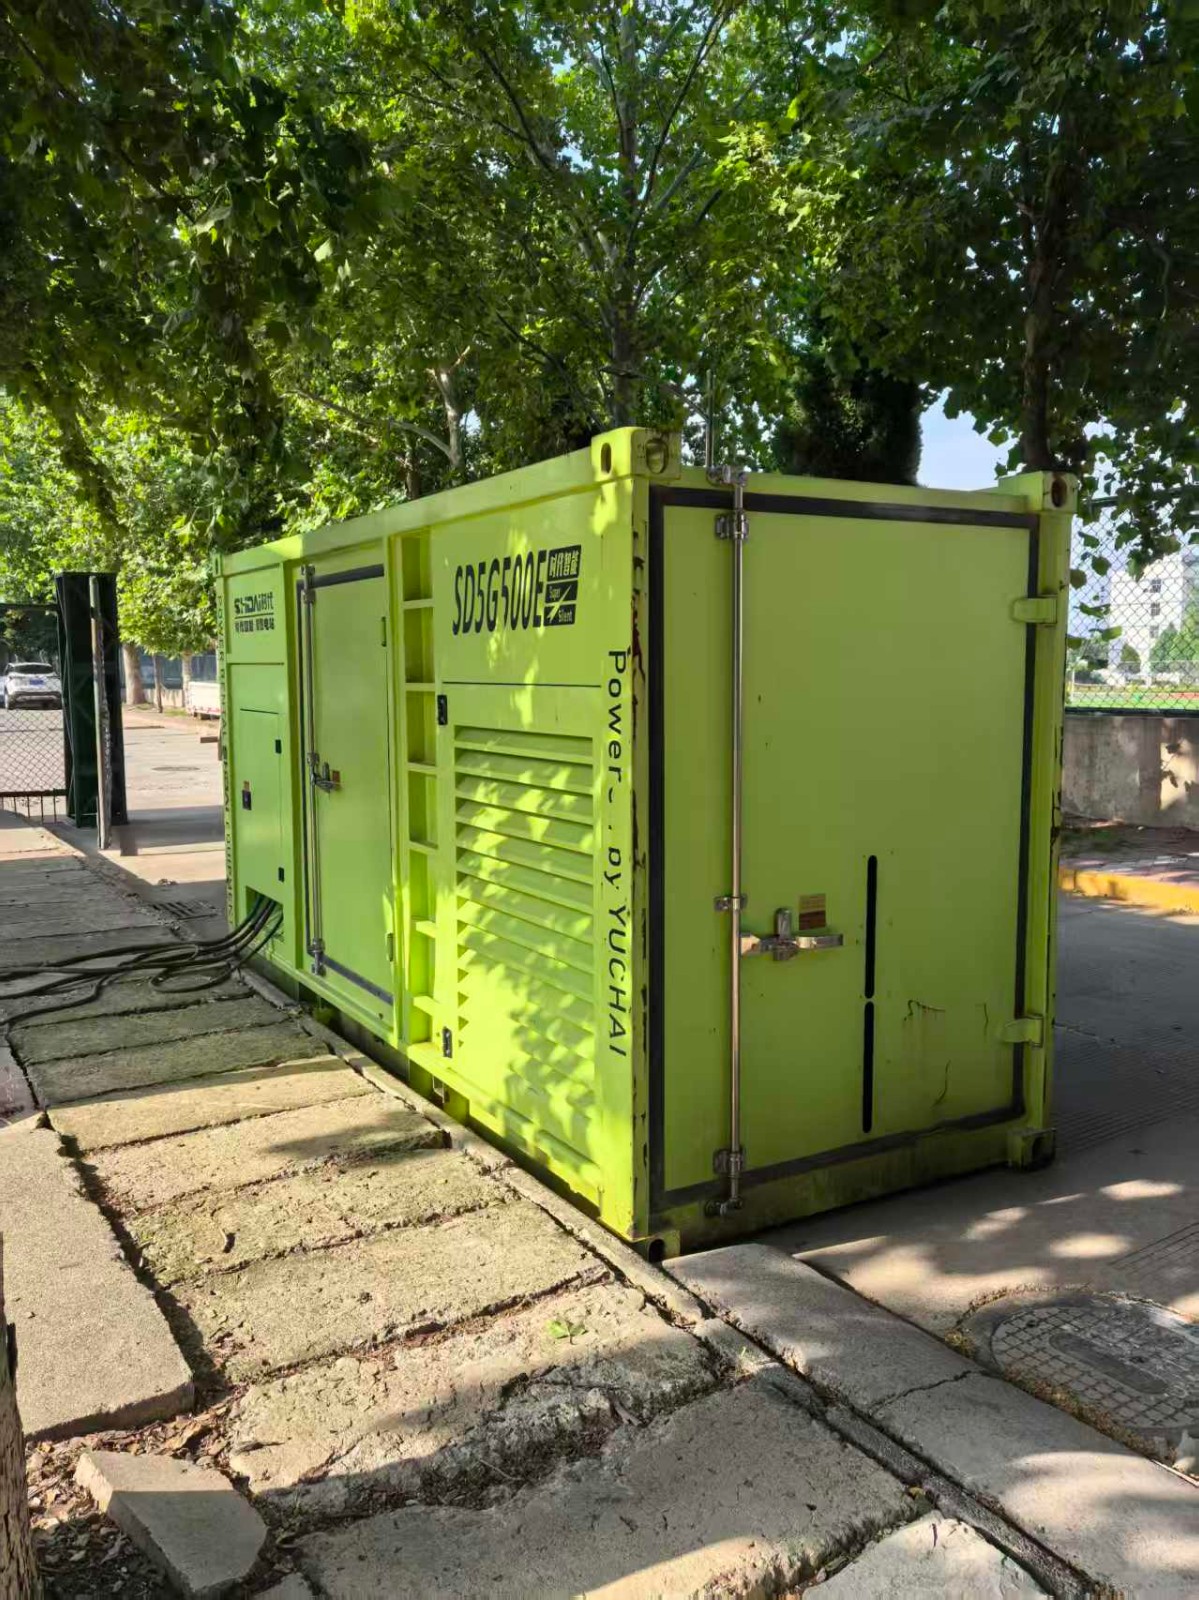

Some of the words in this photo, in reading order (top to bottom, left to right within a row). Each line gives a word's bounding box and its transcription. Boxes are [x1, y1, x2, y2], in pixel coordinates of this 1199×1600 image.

[452, 550, 547, 635] SD5G500E
[549, 586, 561, 600] Super
[558, 607, 572, 622] Silent
[609, 905, 627, 1057] YUCHAI
